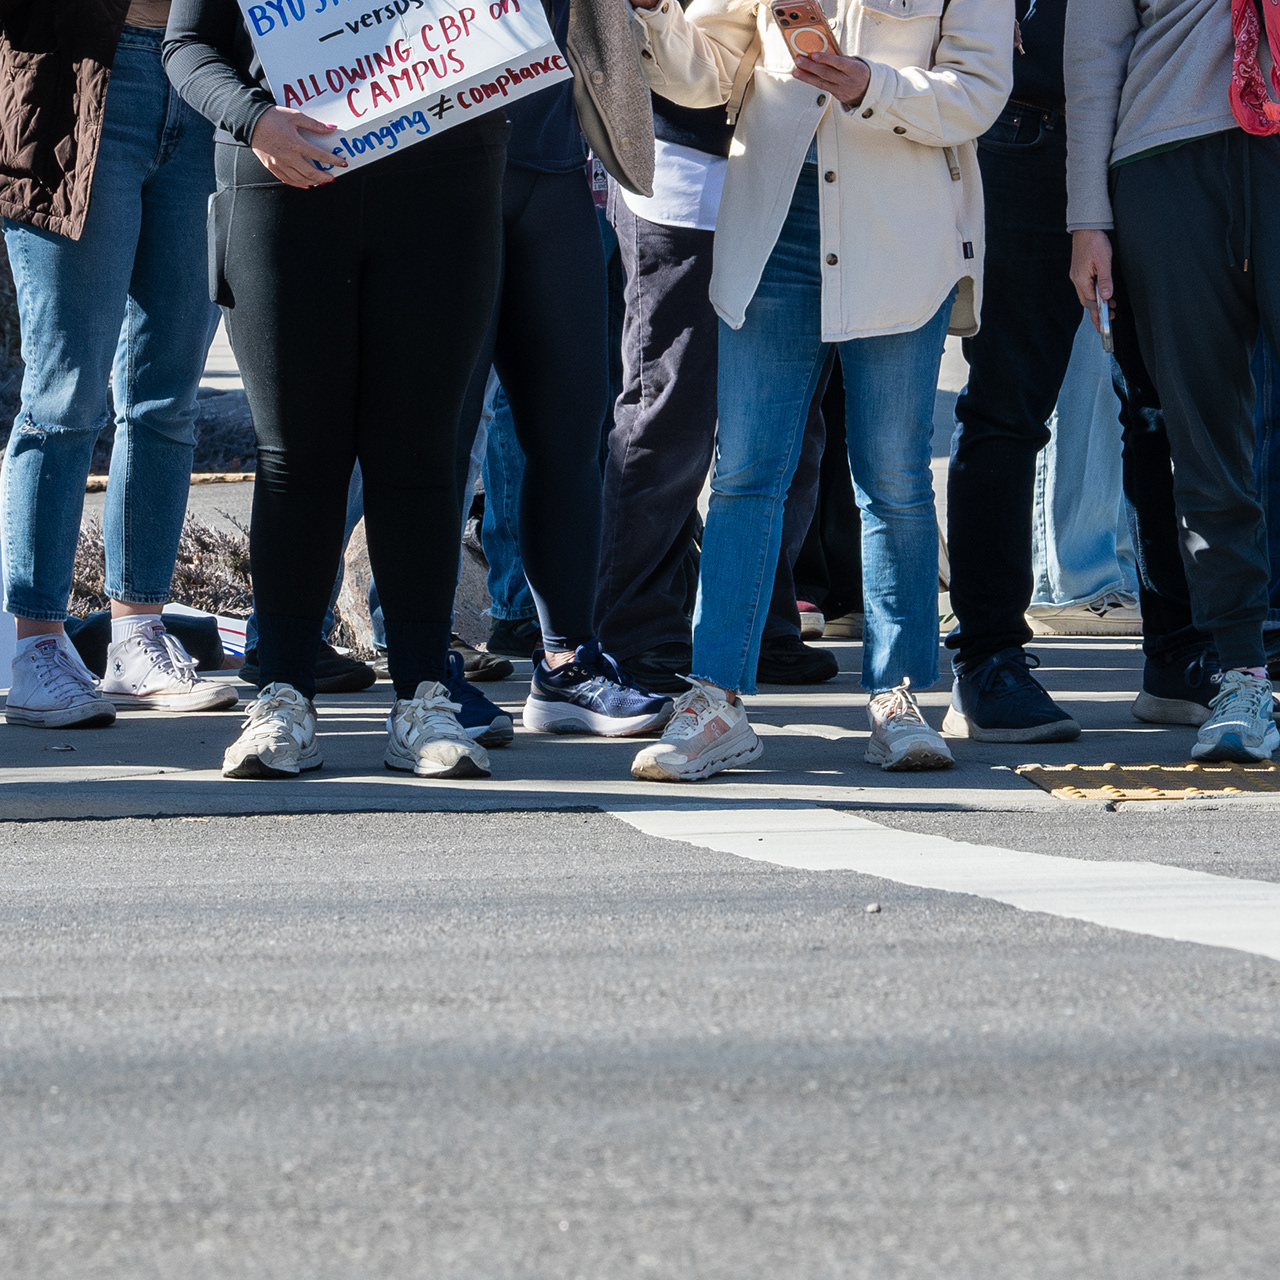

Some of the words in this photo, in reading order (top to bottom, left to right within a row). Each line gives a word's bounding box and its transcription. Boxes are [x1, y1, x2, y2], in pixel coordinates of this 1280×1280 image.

[283, 37, 413, 109] ALLOWING
[419, 6, 476, 53] CBP
[346, 48, 466, 119] CAMPUS
